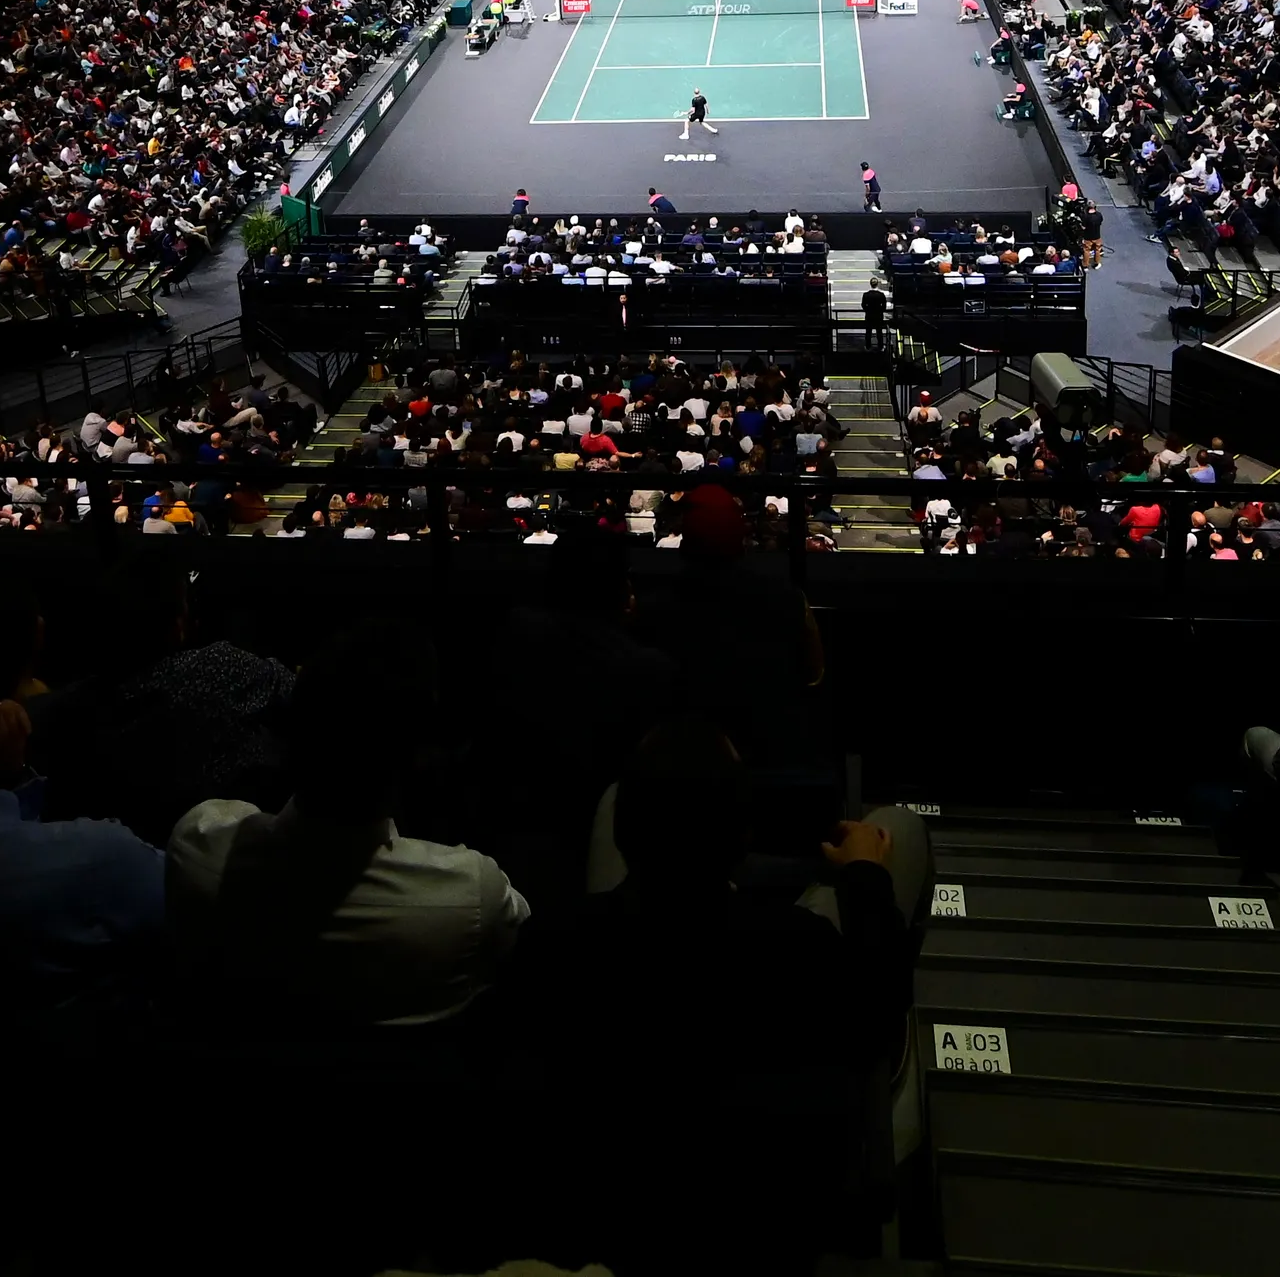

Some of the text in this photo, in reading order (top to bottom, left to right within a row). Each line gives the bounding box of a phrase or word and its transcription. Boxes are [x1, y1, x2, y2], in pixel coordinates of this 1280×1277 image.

[687, 4, 751, 16] ATP TOUR
[889, 2, 916, 11] FedEx
[663, 153, 717, 162] PARIS
[939, 889, 960, 902] 02
[945, 907, 960, 917] 01
[1218, 902, 1230, 914] A
[1241, 902, 1265, 916] 02
[942, 1032, 958, 1050] A
[973, 1034, 1001, 1052] 03
[944, 1057, 1003, 1073] 08 à 01
